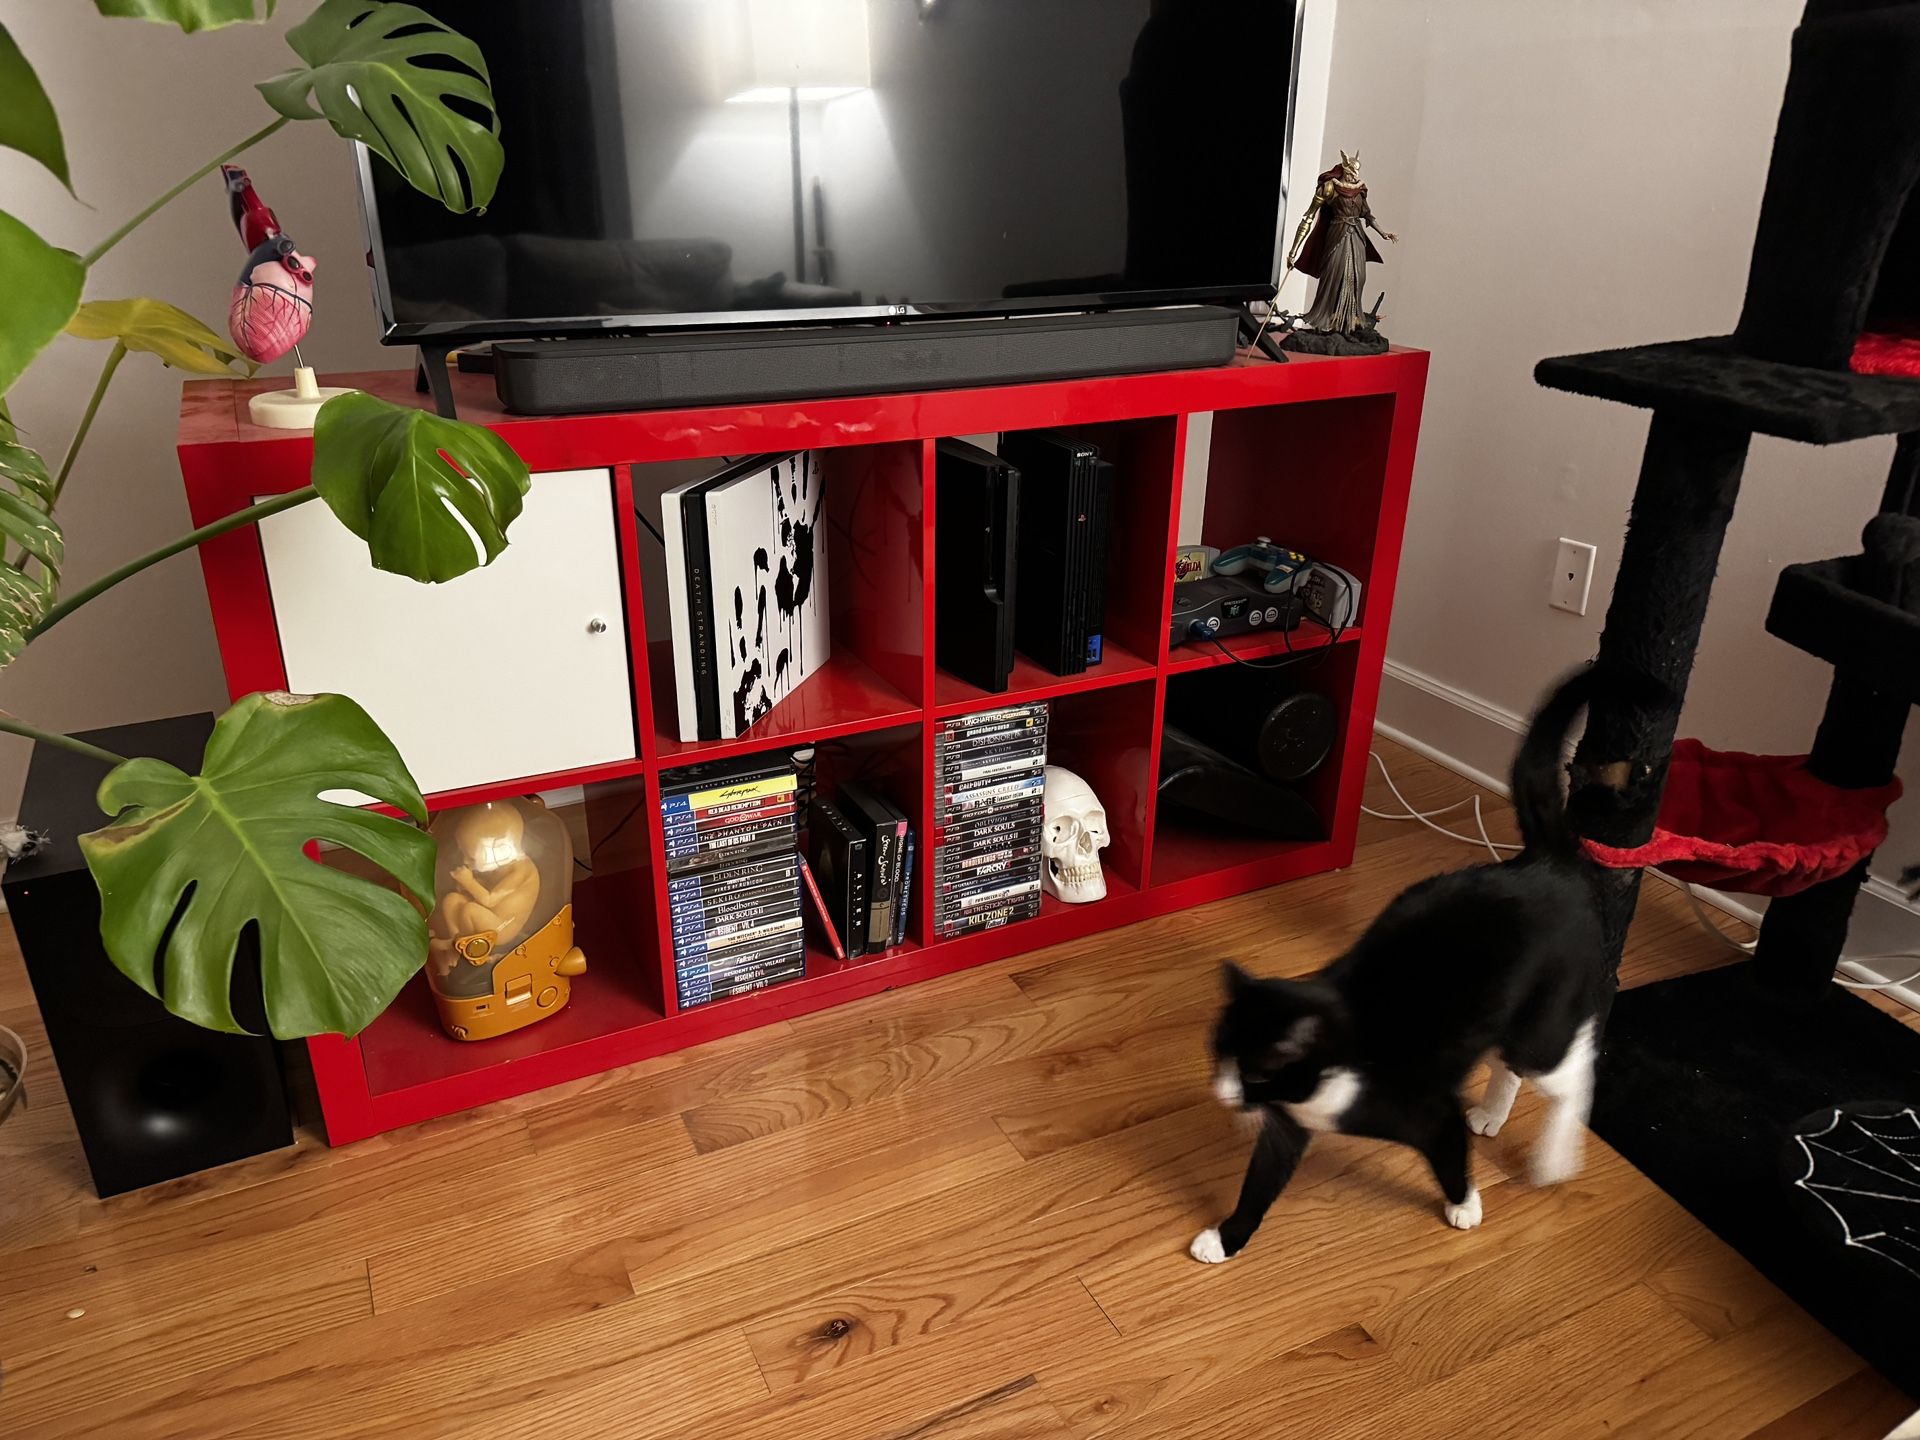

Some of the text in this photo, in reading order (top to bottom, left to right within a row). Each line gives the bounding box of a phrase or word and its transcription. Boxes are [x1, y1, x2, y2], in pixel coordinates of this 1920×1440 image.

[696, 611, 707, 675] STRANDING
[964, 714, 1001, 726] UNCHARTED
[670, 801, 687, 809] PS4
[974, 796, 997, 808] RAGE
[675, 813, 692, 821] PS4
[746, 812, 762, 820] WAR
[717, 824, 758, 838] PHANTOM
[762, 819, 782, 828] PAIN
[974, 822, 1015, 837] DARK SOULS
[973, 838, 991, 848] DARK
[993, 834, 1013, 844] SOULS
[677, 847, 695, 855] PS4
[713, 870, 740, 881] ELDEN
[741, 865, 763, 876] RING
[707, 892, 741, 906] SEKIRO
[901, 872, 909, 916] PROMETHEUS
[718, 900, 759, 914] Bloodborne
[984, 901, 1001, 910] STICK
[1007, 895, 1025, 905] TRUTH
[684, 914, 701, 922] PS4
[715, 914, 734, 924] DARK
[735, 909, 758, 919] SOULS
[968, 908, 1008, 925] KILLZONE
[1009, 906, 1014, 914] 2
[685, 935, 701, 943] PS4
[688, 945, 705, 953] PS4
[687, 957, 704, 965] PS4
[765, 958, 786, 967] VILLAGE
[689, 967, 706, 975] PS4
[690, 978, 706, 986] PS4
[735, 972, 754, 982] RESIDENT
[691, 997, 707, 1005] PS4
